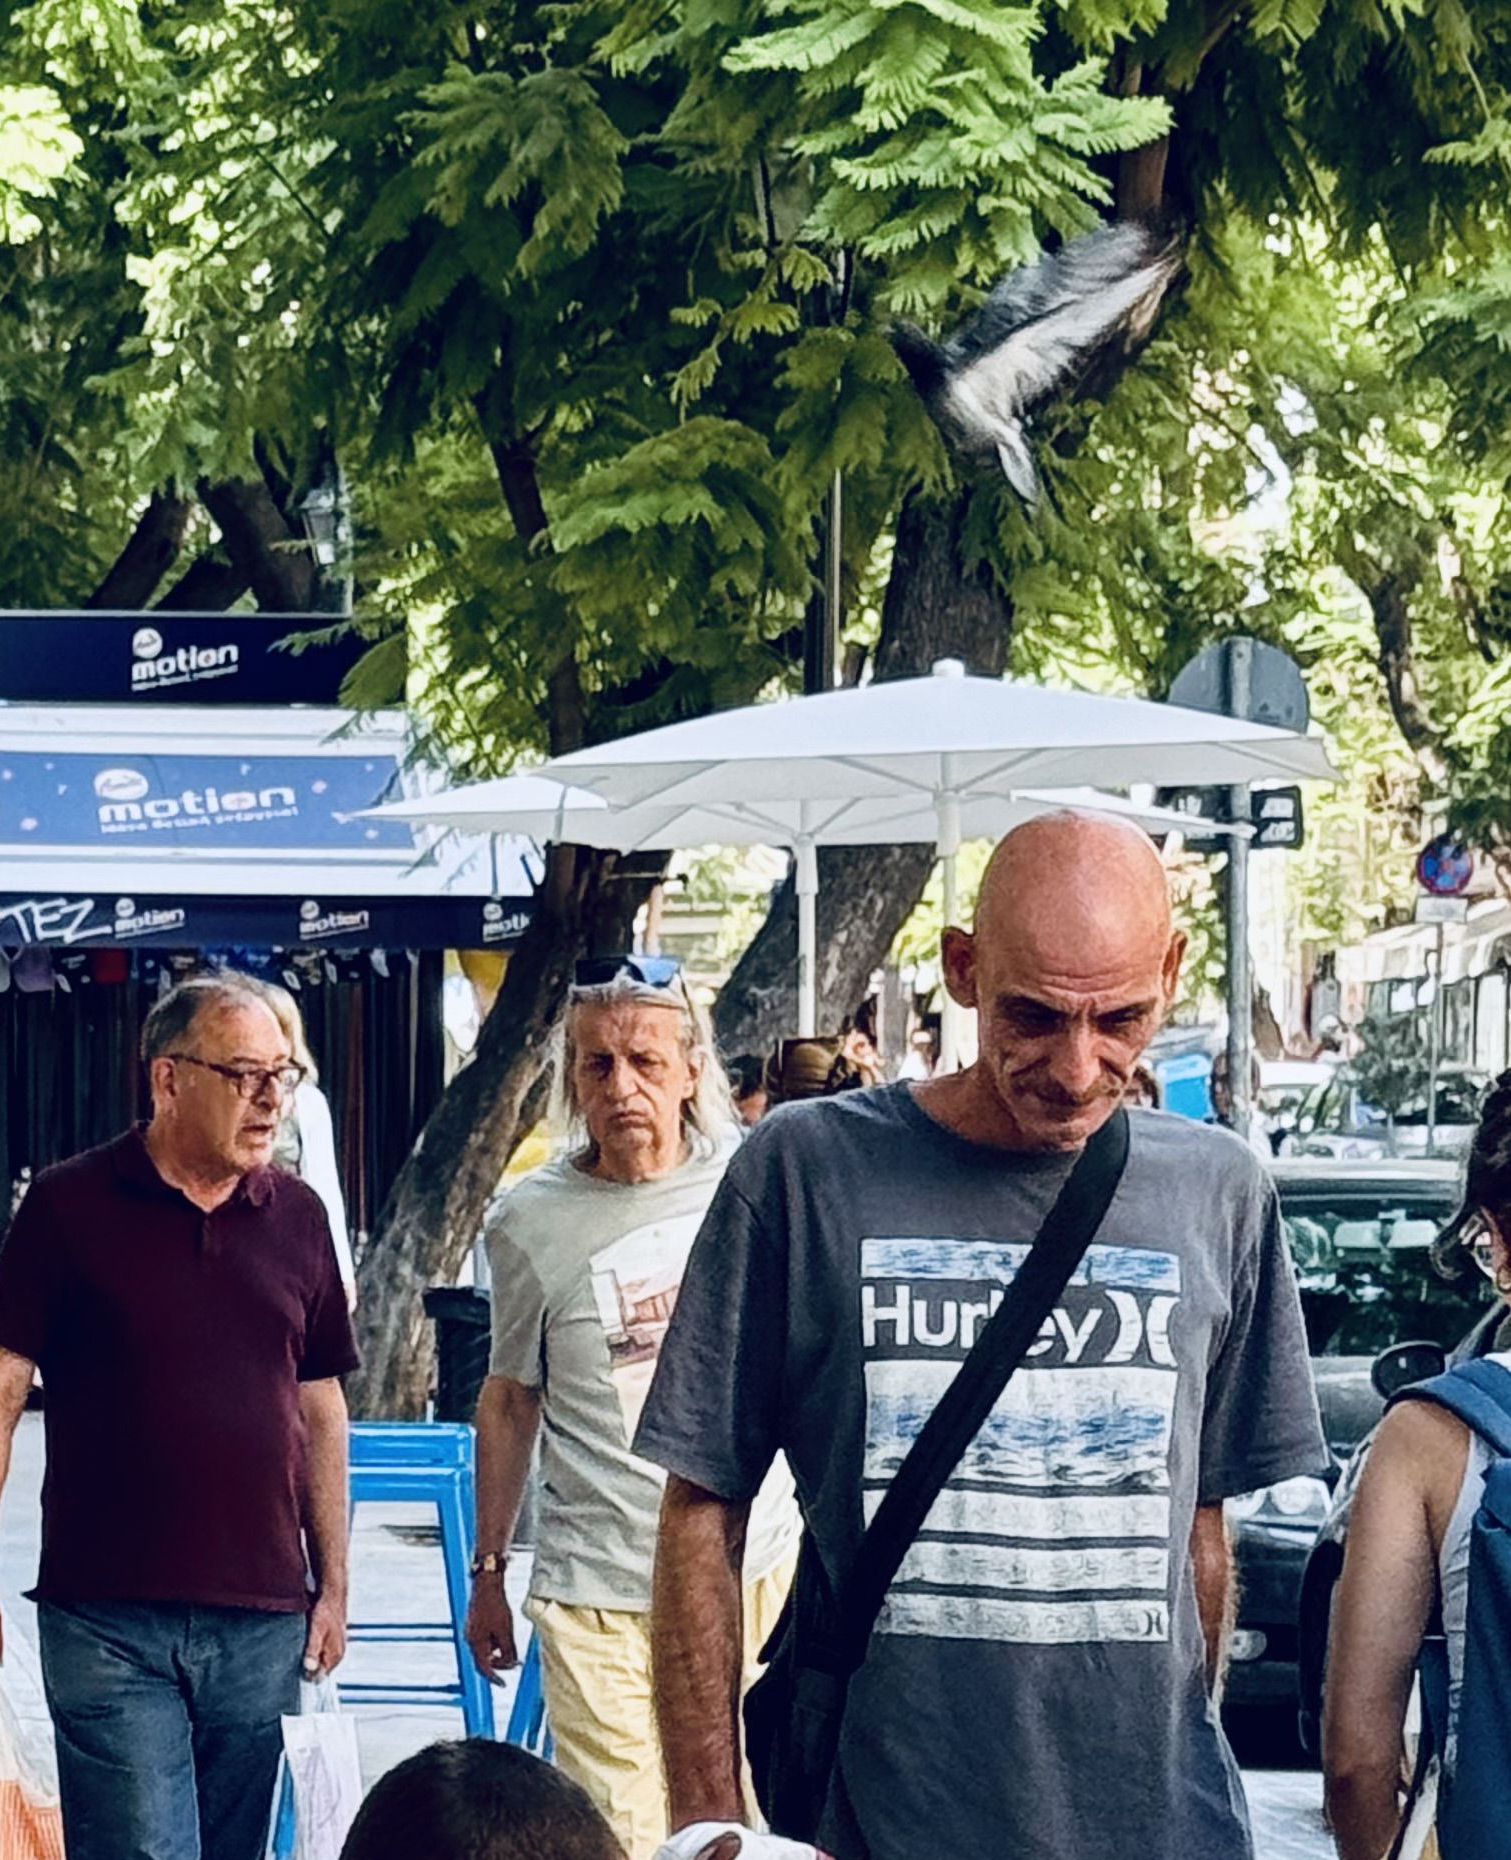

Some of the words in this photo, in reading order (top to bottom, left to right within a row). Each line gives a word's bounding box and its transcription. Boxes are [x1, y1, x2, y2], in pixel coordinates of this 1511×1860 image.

[132, 644, 239, 681] motion
[98, 787, 296, 823] motion
[115, 908, 185, 933] motion
[300, 910, 369, 934] motion
